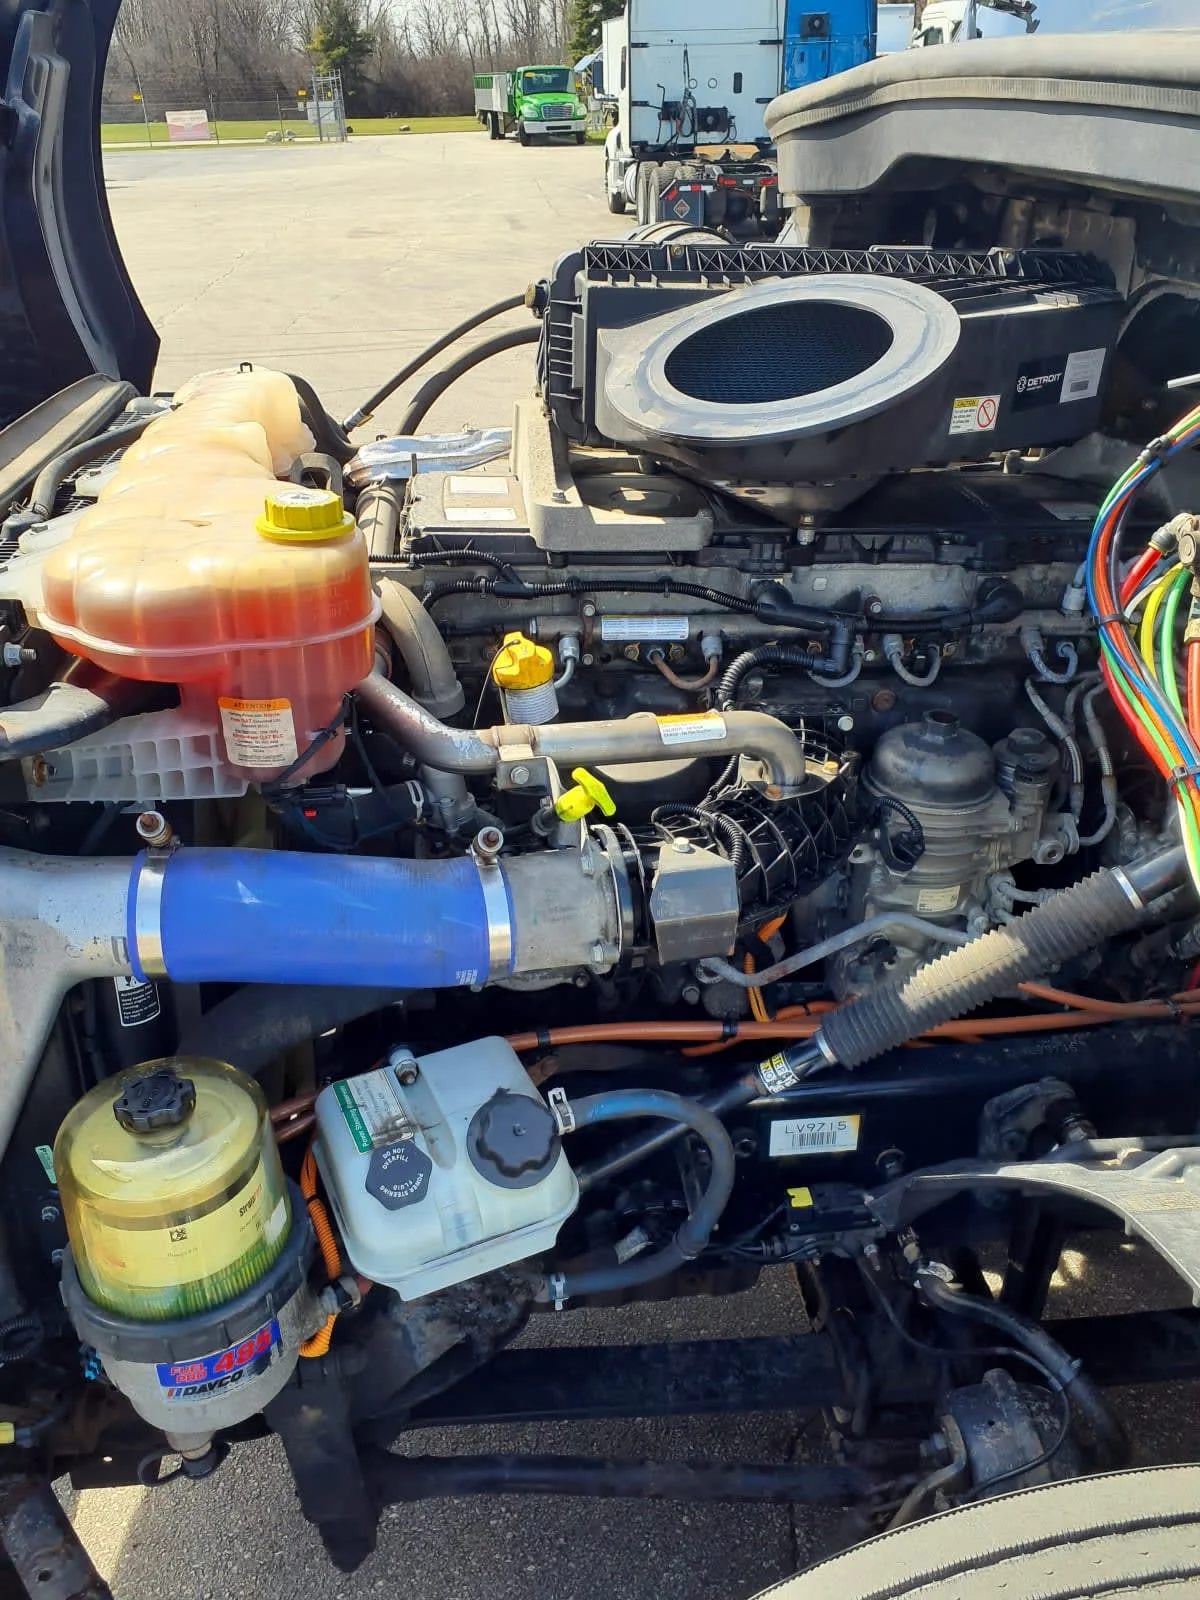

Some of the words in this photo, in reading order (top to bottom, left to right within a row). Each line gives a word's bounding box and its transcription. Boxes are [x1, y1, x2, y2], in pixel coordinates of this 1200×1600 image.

[1027, 373, 1062, 386] DETROIT
[784, 1120, 847, 1135] LV9715
[382, 1151, 391, 1159] DO
[382, 1154, 409, 1170] OVERFILL
[393, 1180, 413, 1190] FLUID
[409, 1173, 424, 1193] POWER
[380, 1185, 409, 1198] STEERING
[214, 1326, 272, 1373] 485
[170, 1361, 207, 1377] FUEL
[175, 1369, 207, 1384] PRO
[183, 1369, 244, 1396] DAVCO
